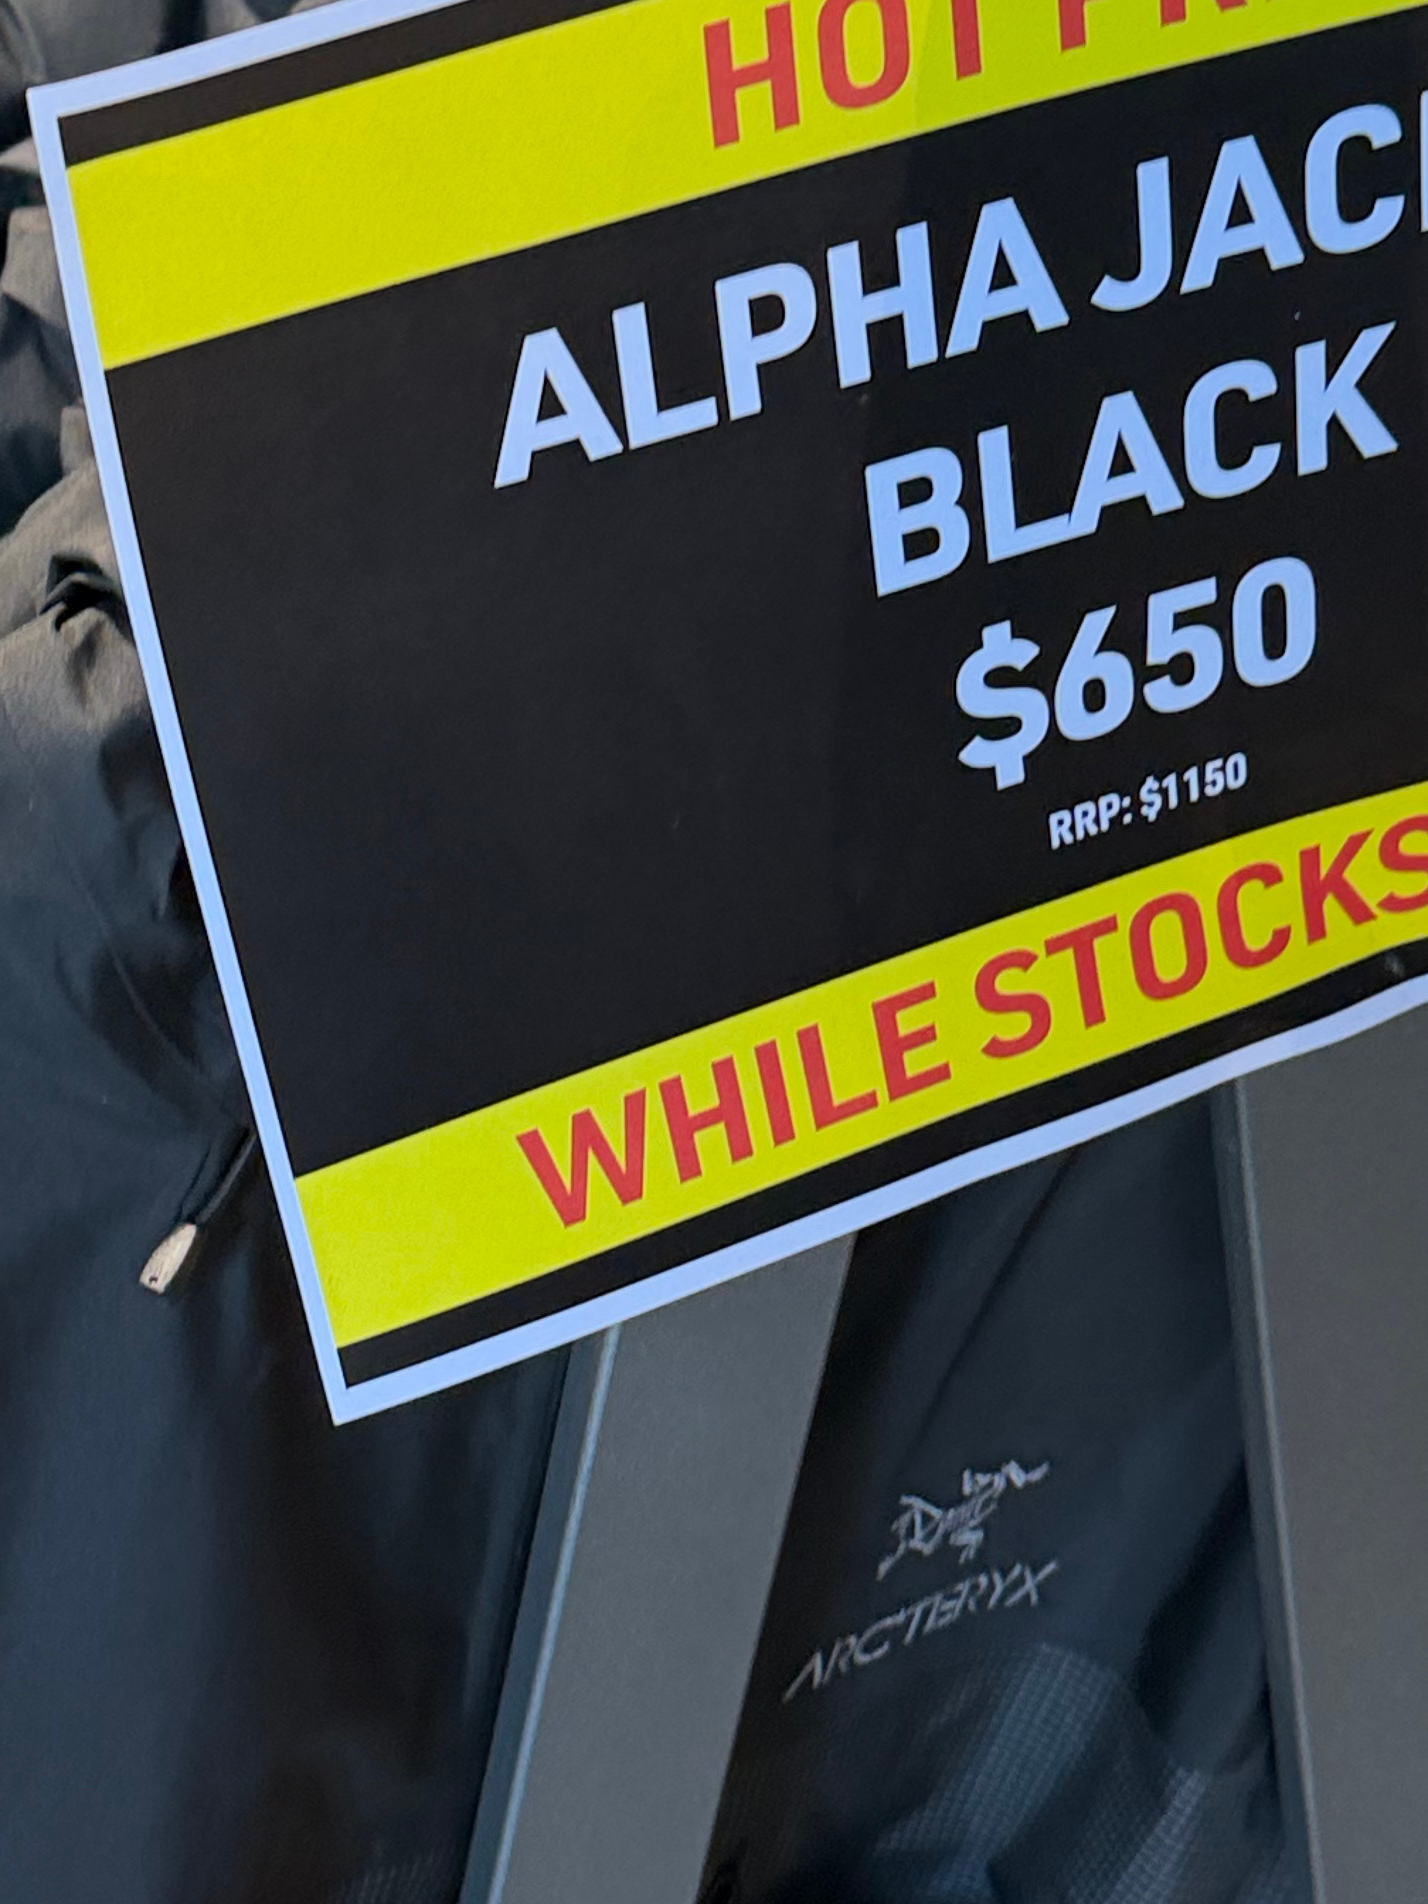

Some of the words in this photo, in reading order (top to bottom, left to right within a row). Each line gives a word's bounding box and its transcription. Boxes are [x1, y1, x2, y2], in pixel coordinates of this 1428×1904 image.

[496, 197, 1069, 488] ALPHA
[865, 322, 1397, 596] BLACK
[956, 557, 1316, 789] $650
[1049, 793, 1133, 849] RRP:
[1139, 752, 1247, 822] $1150
[518, 982, 951, 1226] WHILE
